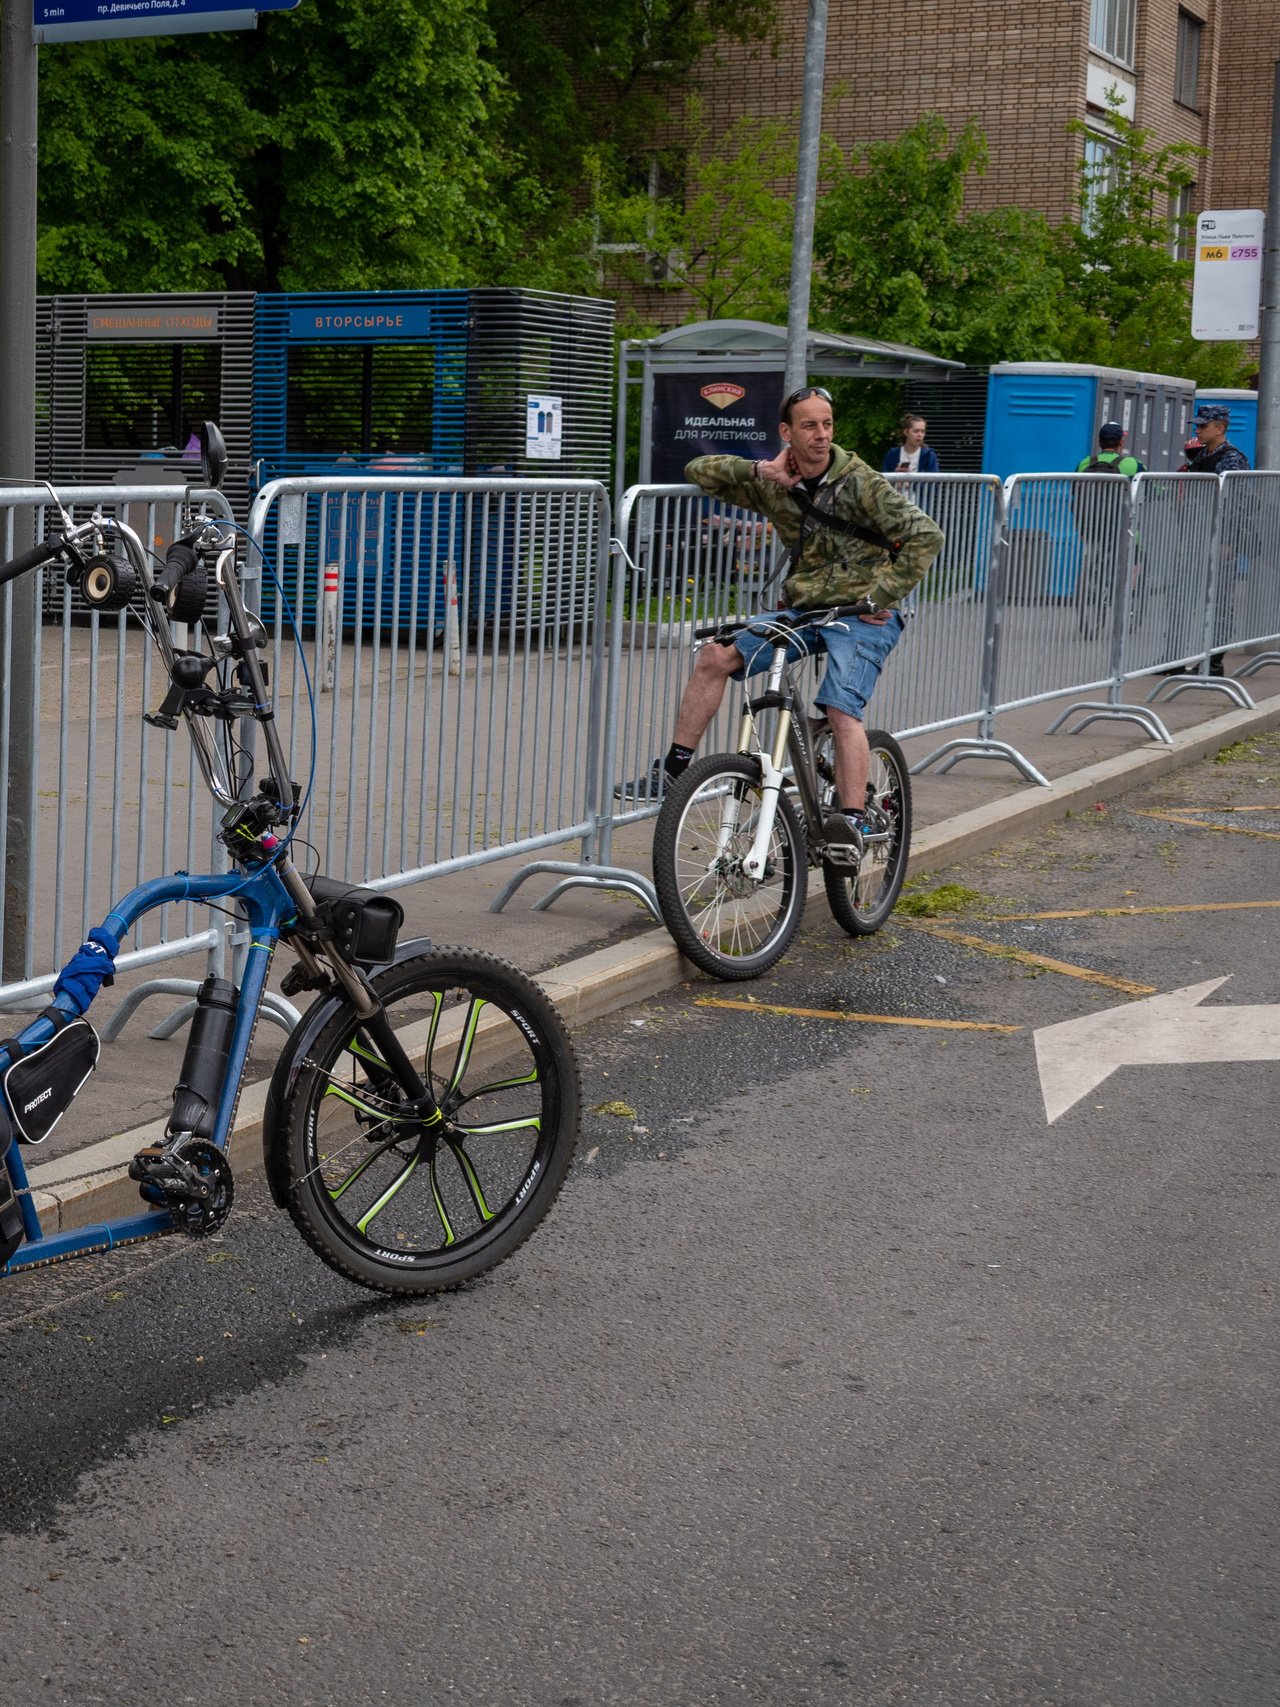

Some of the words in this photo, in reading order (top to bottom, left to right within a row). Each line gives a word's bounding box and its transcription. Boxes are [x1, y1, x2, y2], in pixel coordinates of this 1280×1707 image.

[44, 8, 49, 18] 5
[50, 7, 65, 17] min
[97, 5, 109, 15] пр.
[110, 3, 150, 13] Девичьего
[151, 0, 172, 9] Поля,
[1206, 249, 1223, 259] м6
[1231, 248, 1258, 258] с755
[93, 317, 163, 329] СМЕШАННЫЕ
[165, 316, 213, 329] ОТХОДЫ
[315, 315, 404, 328] ВТОРСЫРЬЕ
[703, 385, 742, 396] КЛИНСКИЙ
[684, 416, 756, 428] ИДЕАЛЬНАЯ
[674, 429, 699, 440] ДЛЯ
[700, 430, 767, 441] РУЛЕТИКОВ
[510, 1009, 541, 1046] SPORT
[24, 1087, 52, 1113] PROTECT
[515, 1160, 540, 1206] SPORT
[374, 1249, 416, 1262] SPORT
